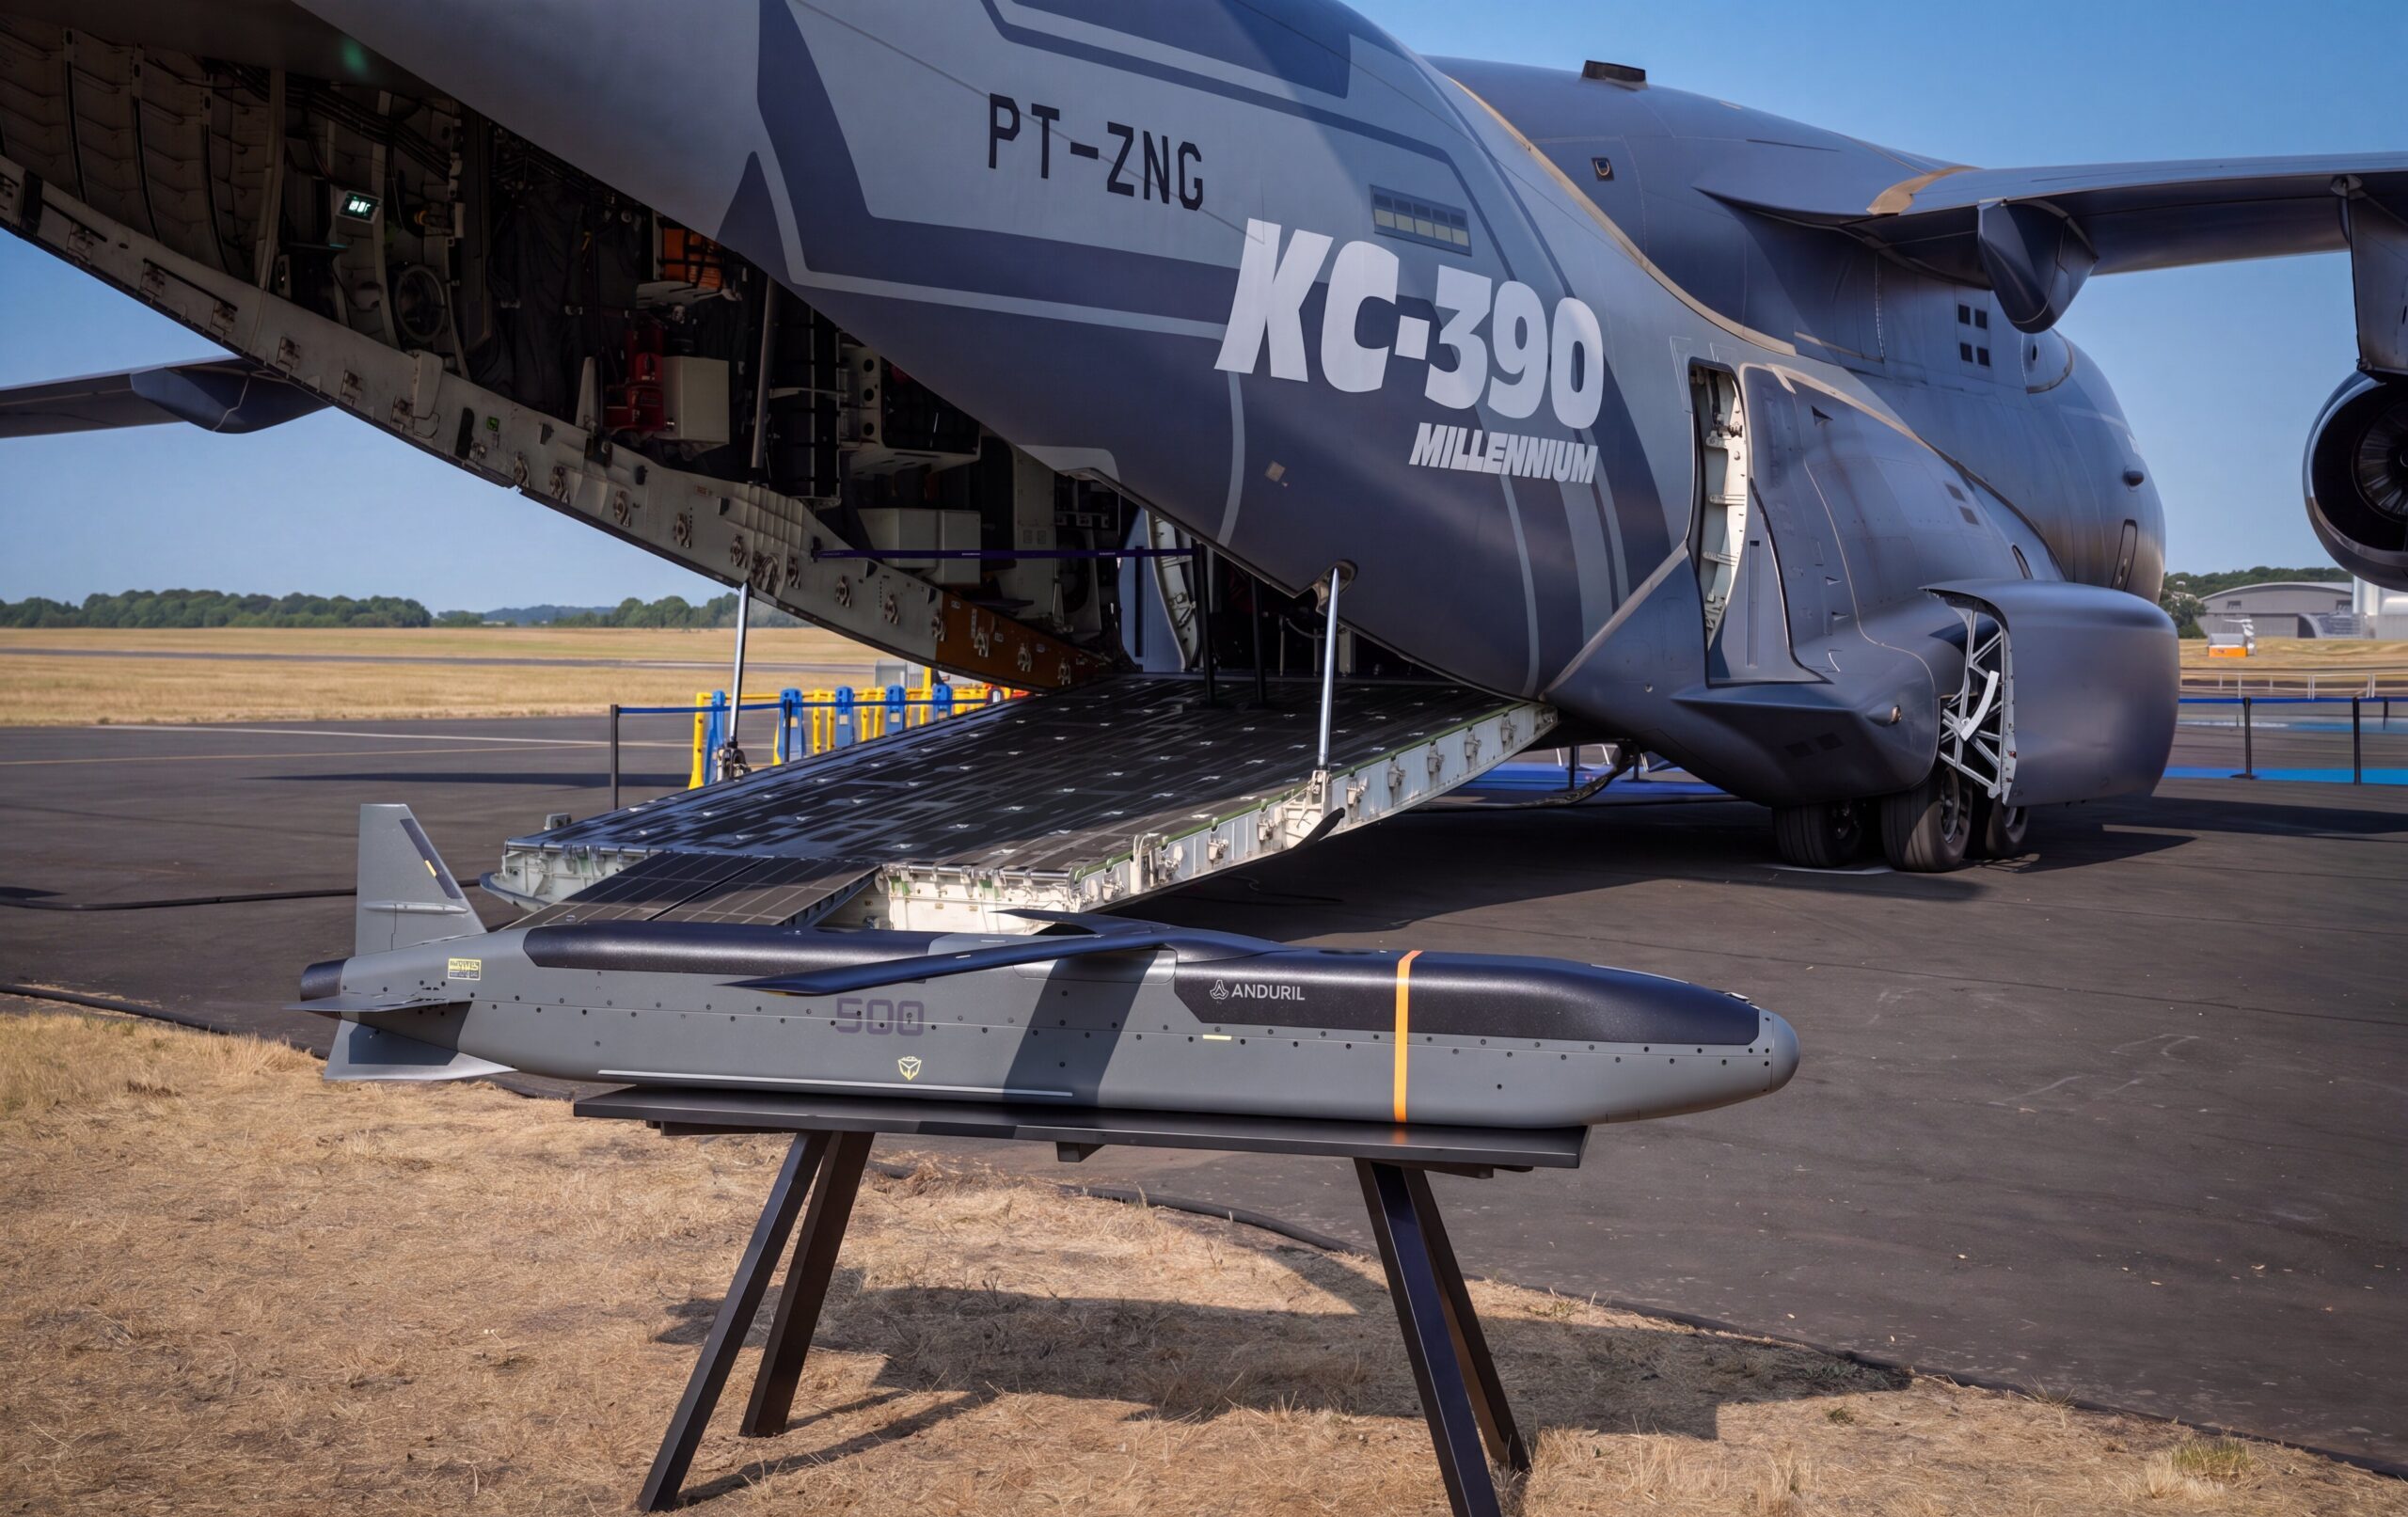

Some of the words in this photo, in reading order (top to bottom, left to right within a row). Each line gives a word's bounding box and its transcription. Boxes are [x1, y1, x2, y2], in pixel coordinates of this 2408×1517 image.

[988, 92, 1203, 212] PT-ZNG
[1214, 217, 1603, 430] KC-390
[1409, 421, 1598, 484] MILLENNIUM
[835, 998, 925, 1036] 500
[1231, 983, 1306, 1001] ANDURIL
